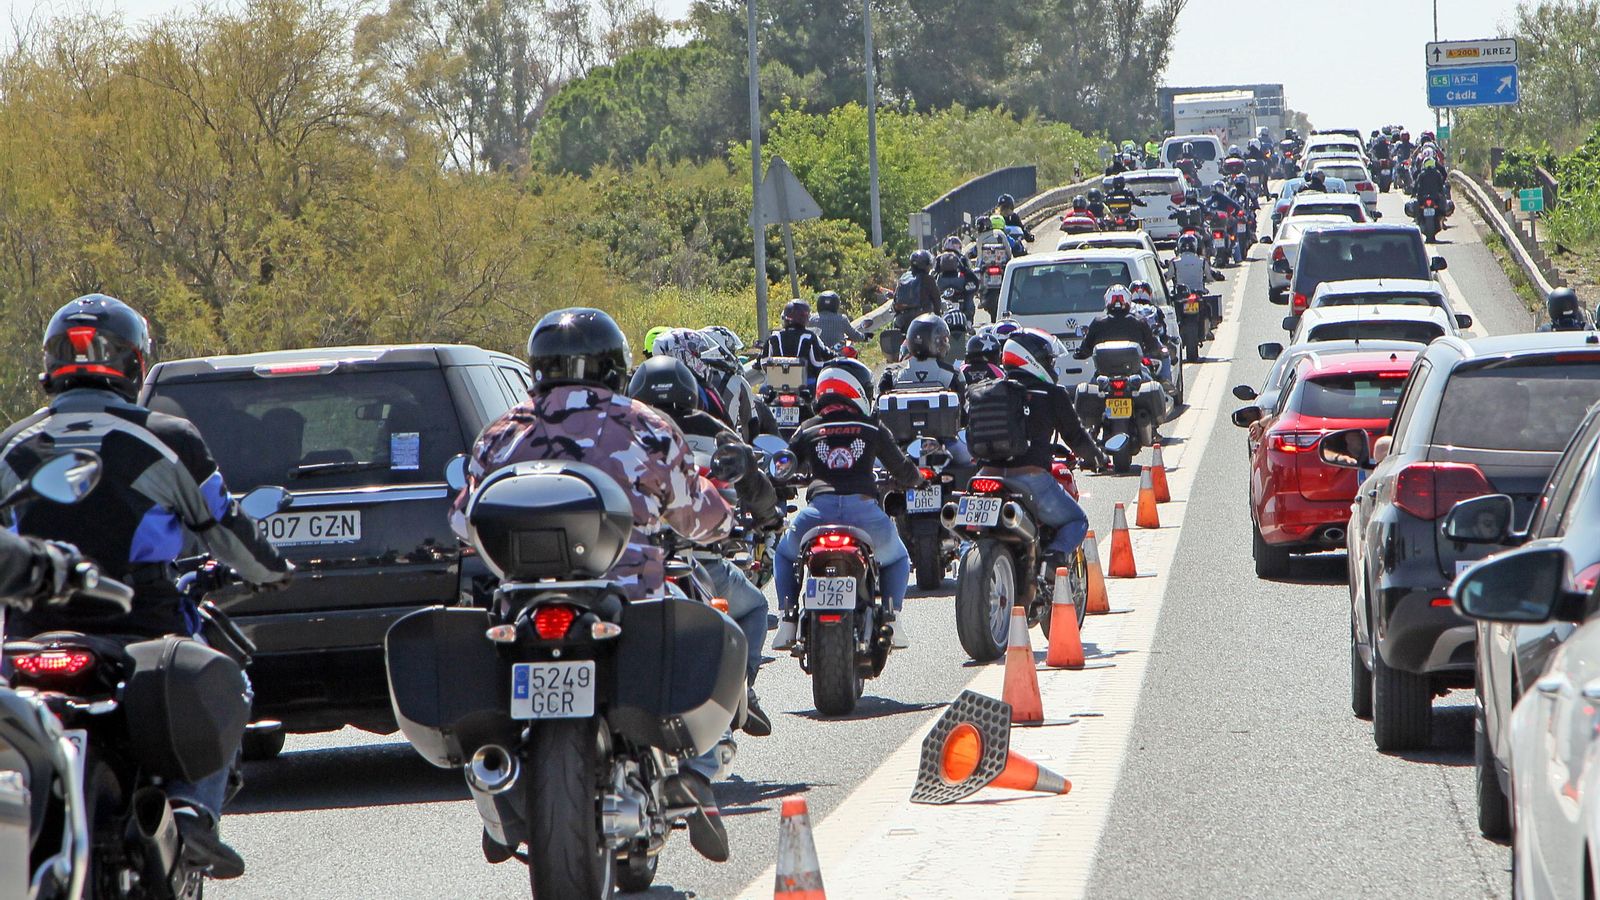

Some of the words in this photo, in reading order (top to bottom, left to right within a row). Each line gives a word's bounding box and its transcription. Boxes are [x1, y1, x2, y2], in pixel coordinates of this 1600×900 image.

[1482, 47, 1511, 56] JEREZ
[1432, 77, 1448, 85] E-5
[1454, 75, 1476, 84] AP-4
[968, 500, 998, 511] 5305
[309, 515, 355, 537] GZN
[818, 580, 854, 592] 6429
[817, 593, 844, 606] JZR
[532, 666, 590, 689] 5249
[531, 691, 574, 714] GCR
